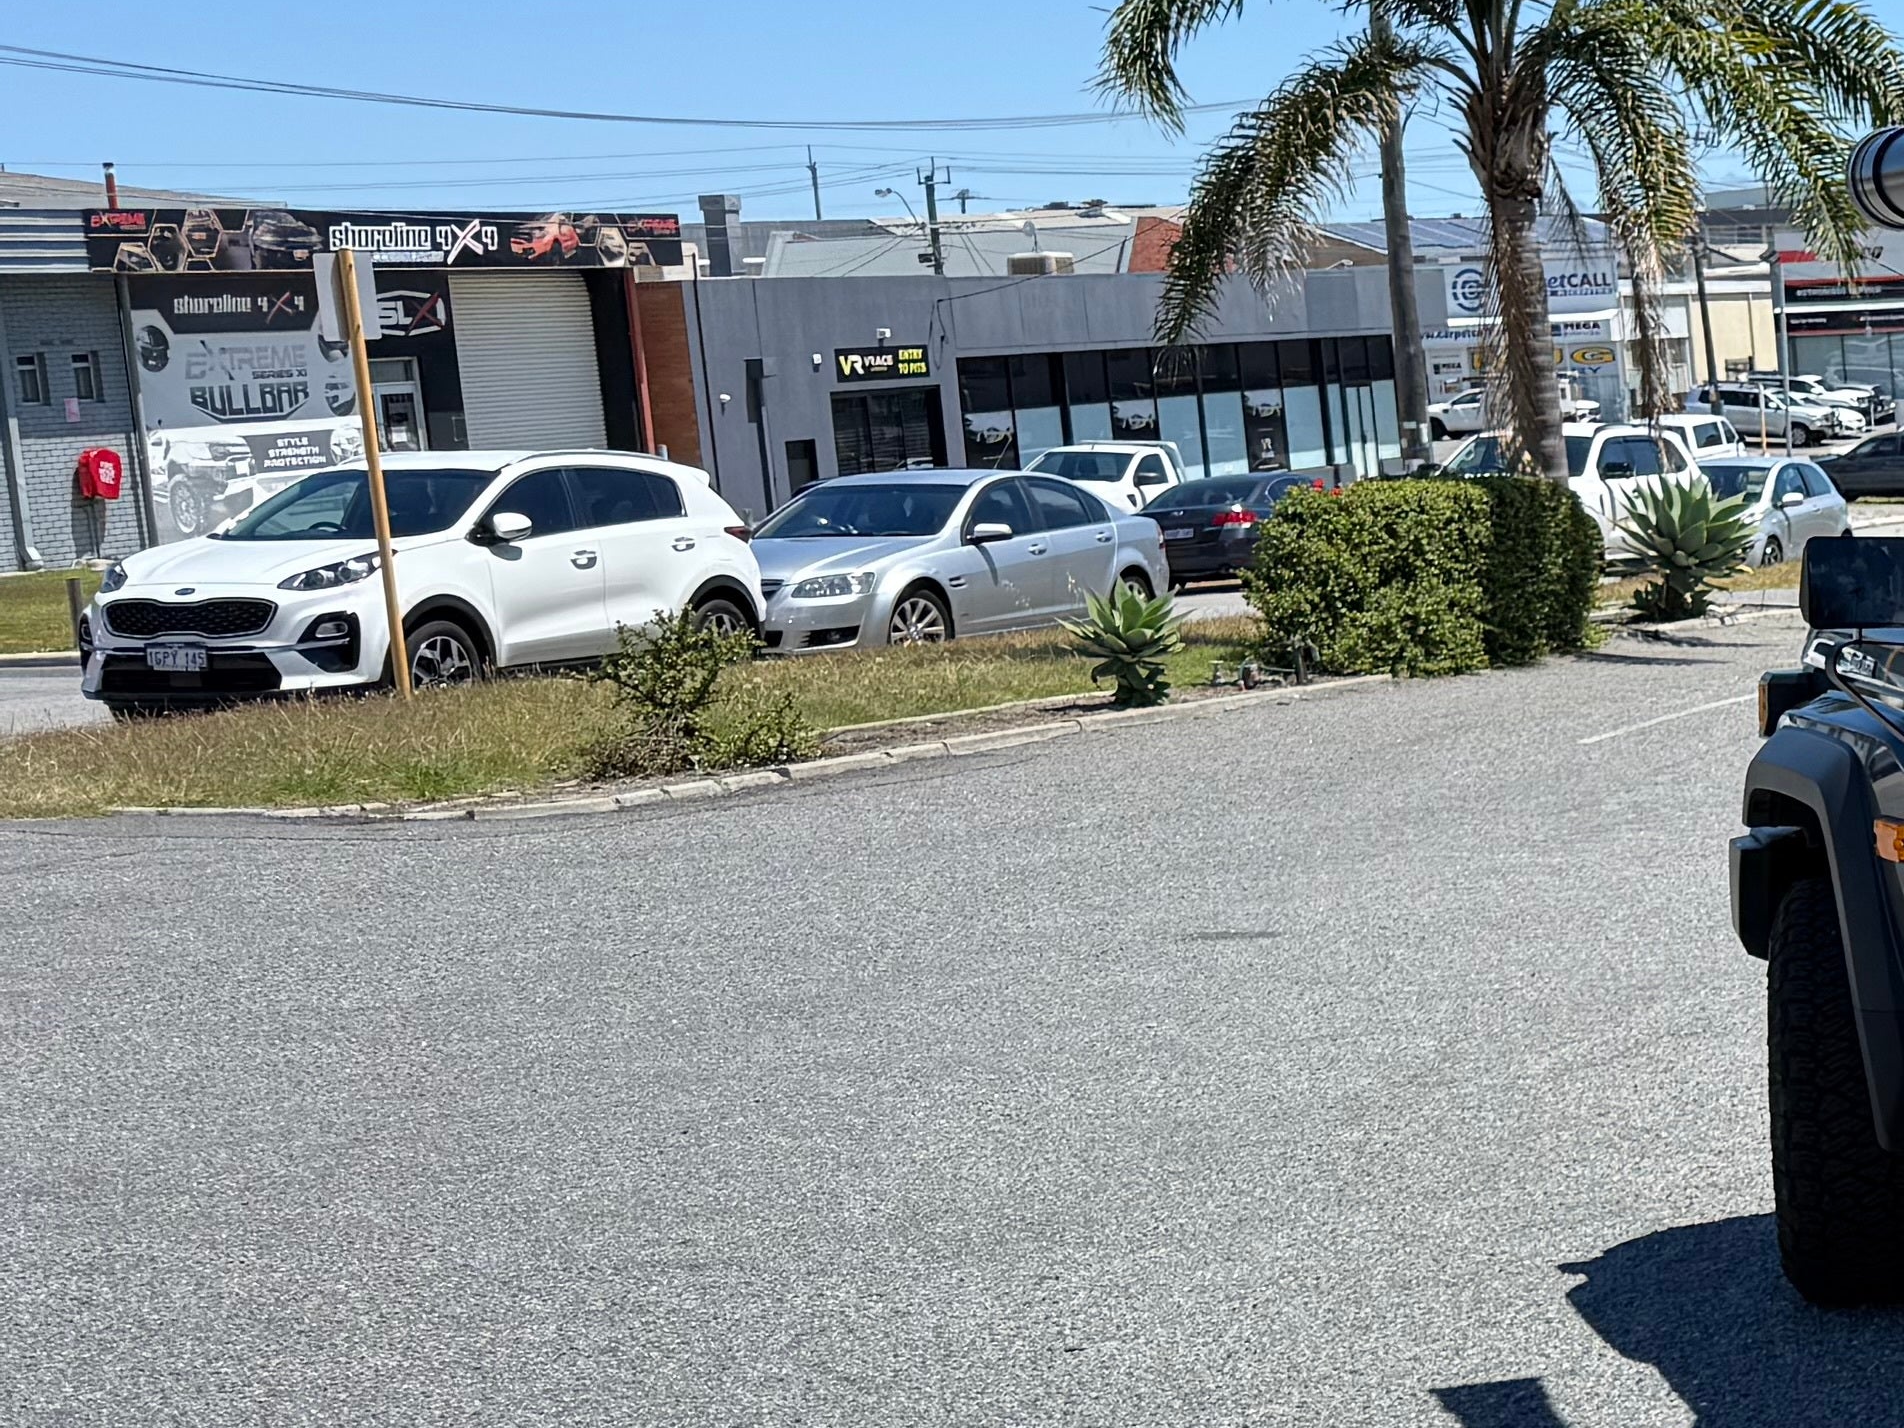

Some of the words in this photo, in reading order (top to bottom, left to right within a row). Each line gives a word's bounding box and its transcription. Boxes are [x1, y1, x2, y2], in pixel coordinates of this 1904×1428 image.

[329, 222, 432, 251] shoreline
[173, 294, 251, 314] shoreline
[189, 380, 310, 416] BULLBAR
[276, 437, 309, 448] STYLE
